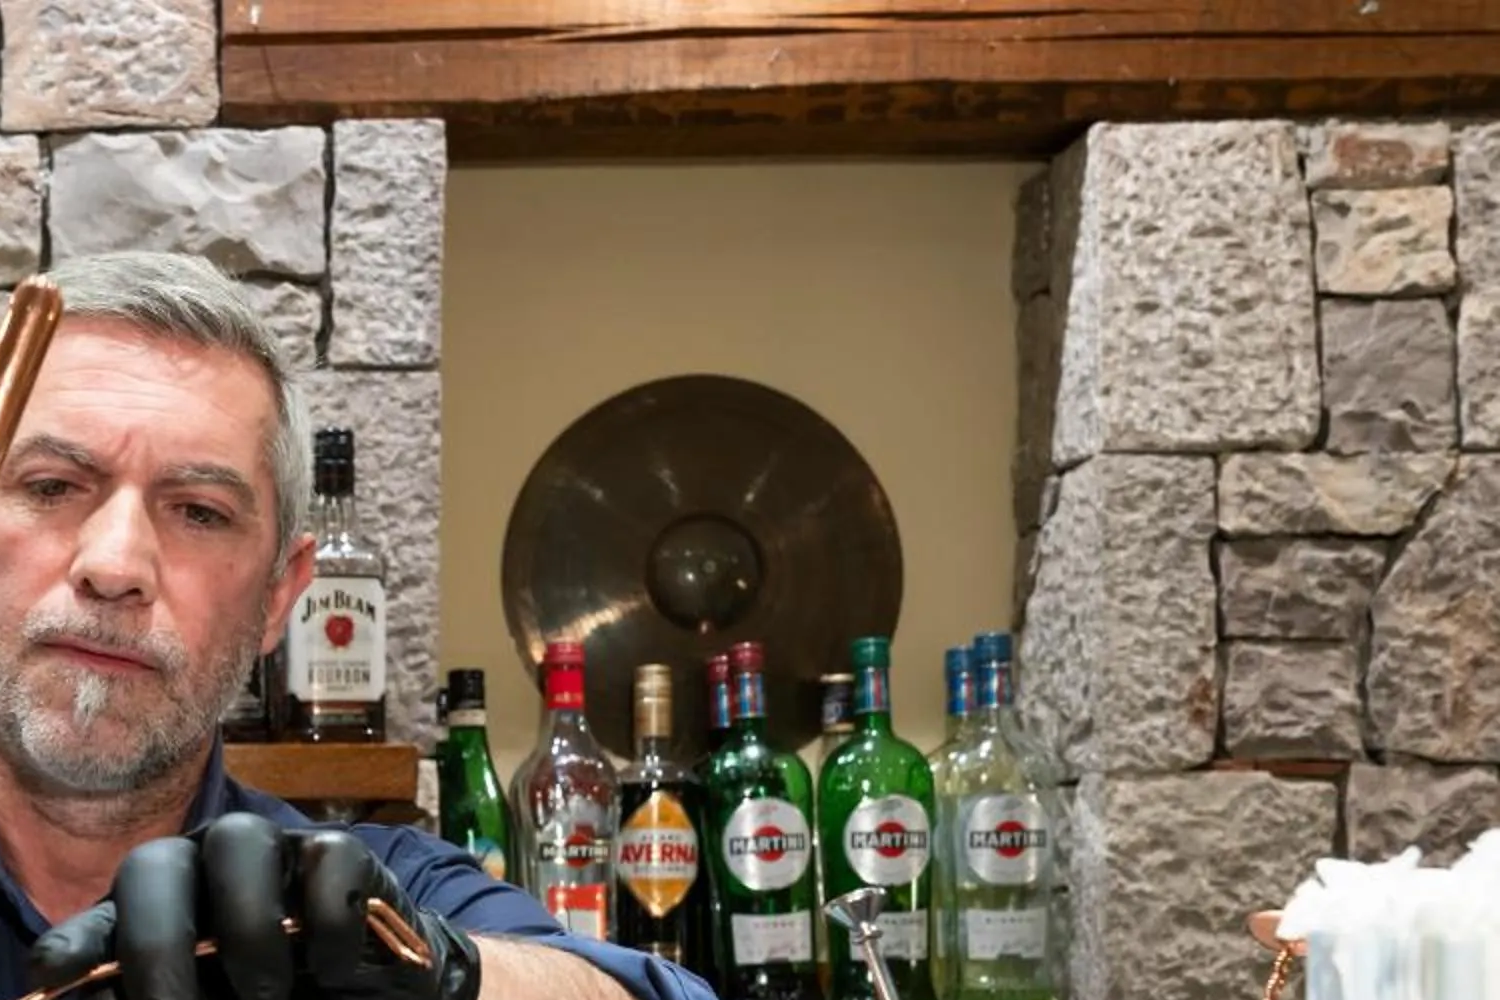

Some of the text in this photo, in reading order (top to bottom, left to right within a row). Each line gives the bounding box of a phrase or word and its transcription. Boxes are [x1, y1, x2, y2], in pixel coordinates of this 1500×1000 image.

[731, 834, 804, 856] MARTINI
[851, 831, 927, 850] MARTINI
[970, 830, 1047, 849] MARTINI
